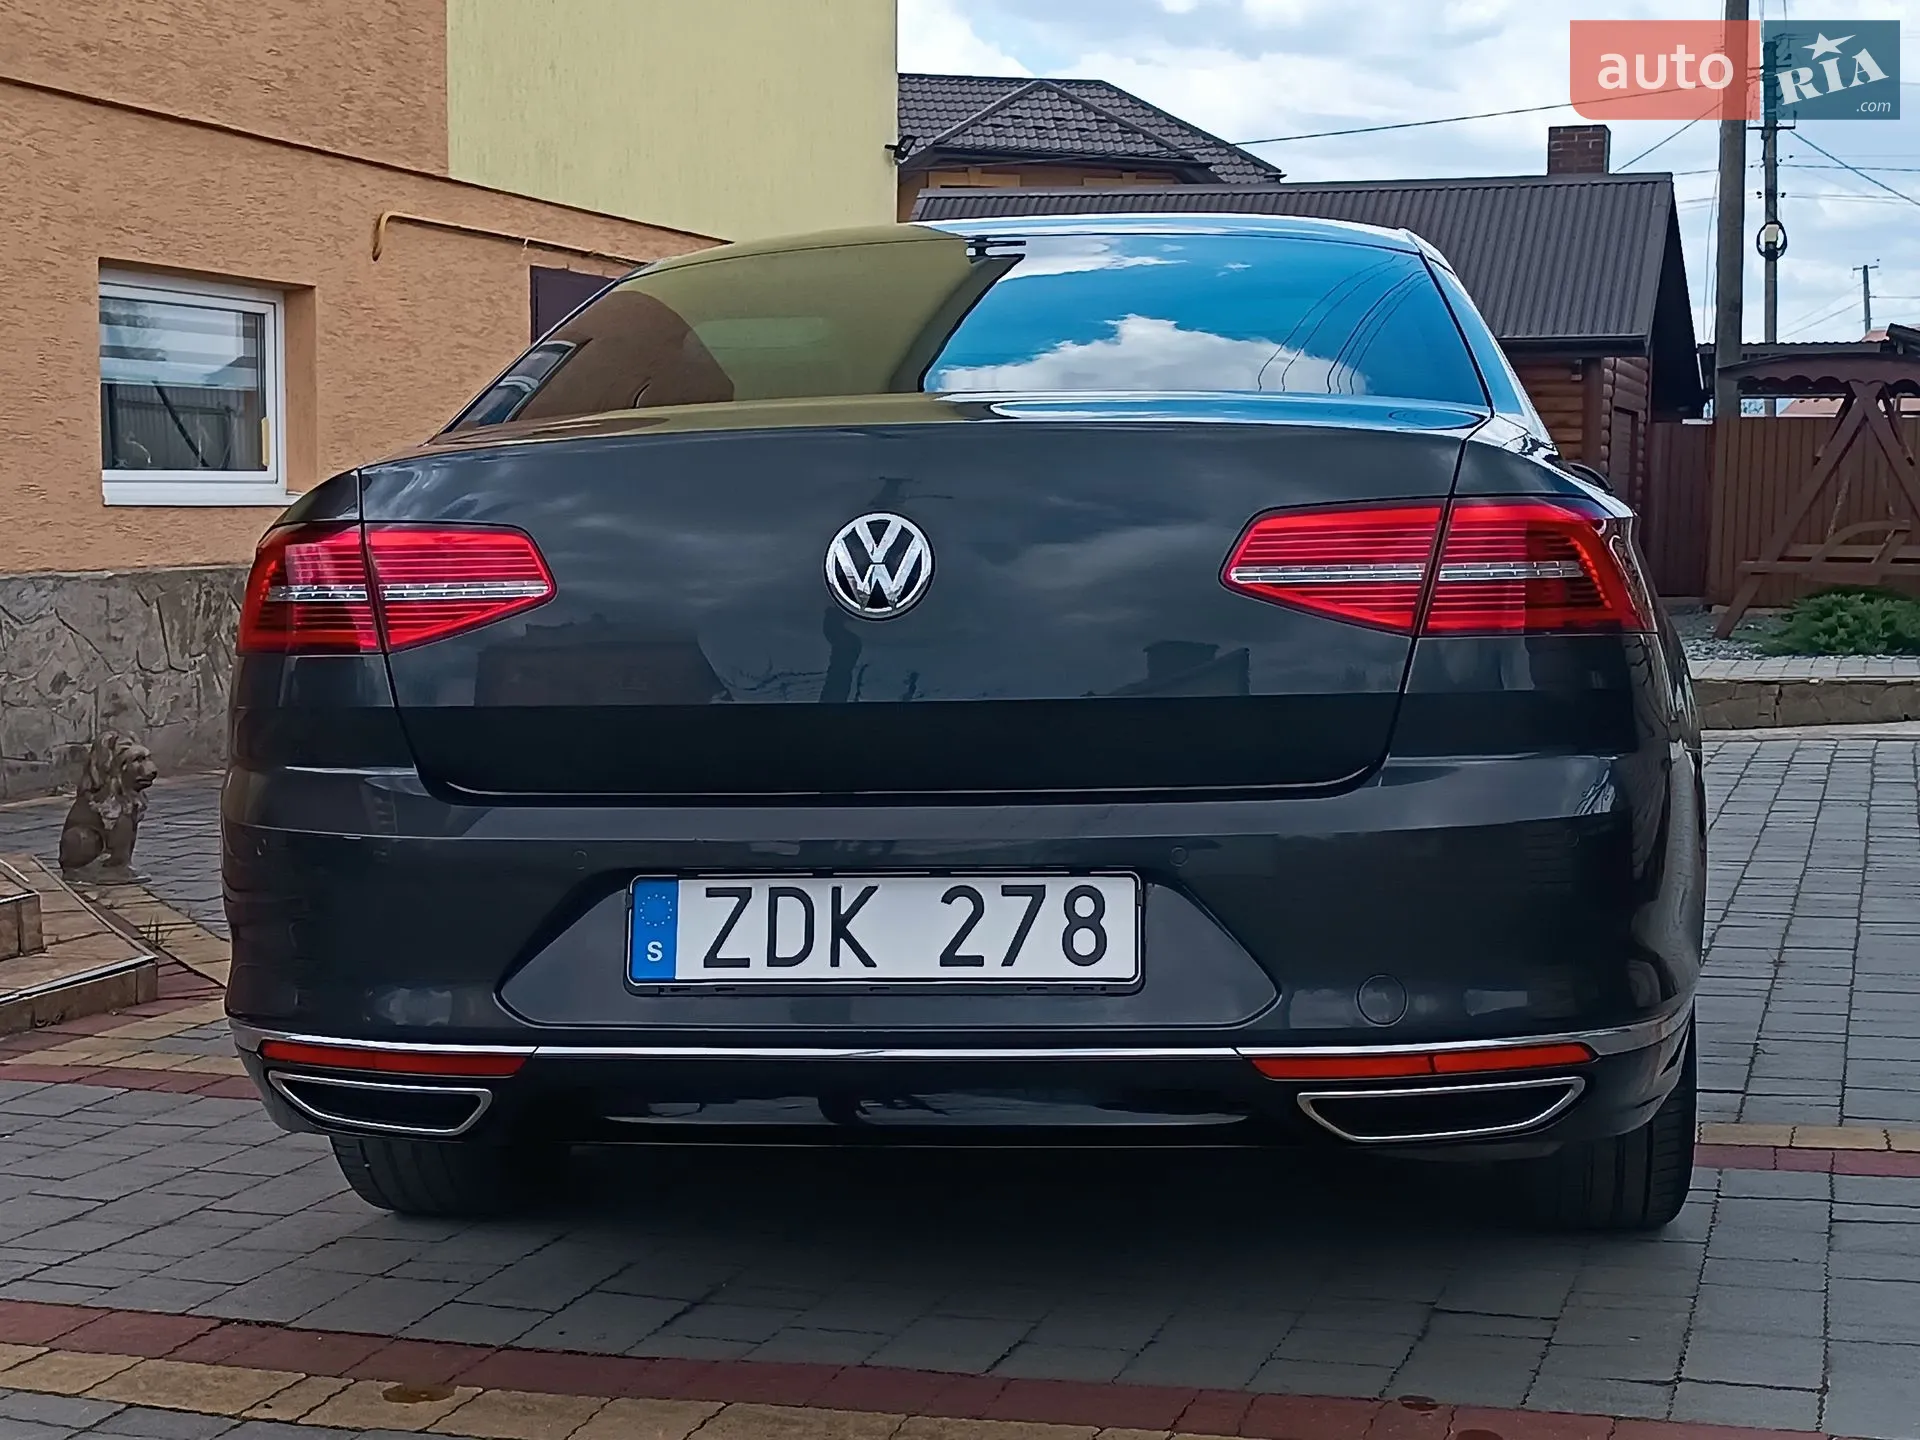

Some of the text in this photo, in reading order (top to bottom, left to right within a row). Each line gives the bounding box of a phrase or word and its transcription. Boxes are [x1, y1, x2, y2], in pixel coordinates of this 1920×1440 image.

[646, 941, 663, 962] S
[703, 885, 1107, 968] ZDK 278
